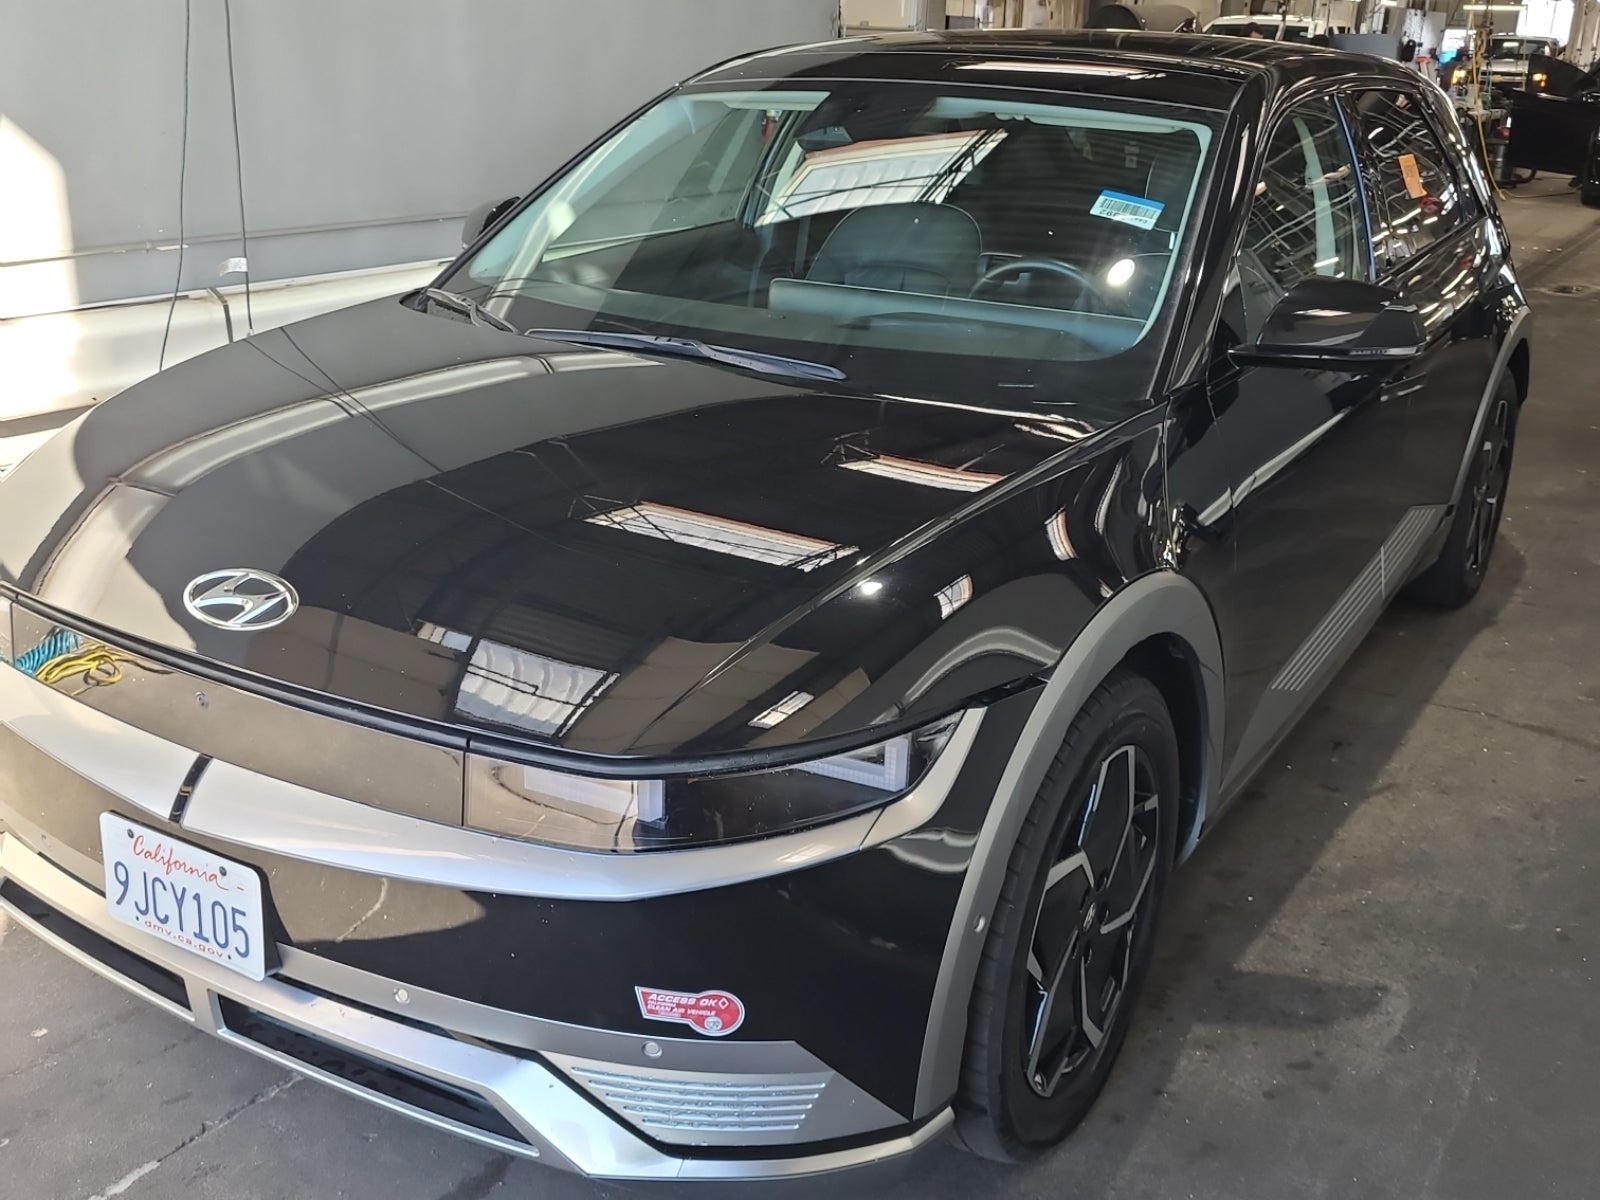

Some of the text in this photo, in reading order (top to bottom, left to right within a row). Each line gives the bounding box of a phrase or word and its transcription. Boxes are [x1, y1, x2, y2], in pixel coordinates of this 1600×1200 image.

[133, 834, 229, 891] California
[114, 860, 250, 958] 9JCY105
[144, 919, 225, 959] dmv.ca.gov
[647, 993, 718, 1007] ACCESS OK
[647, 1004, 671, 1012] CLEAN
[687, 1008, 717, 1016] VEHICLE
